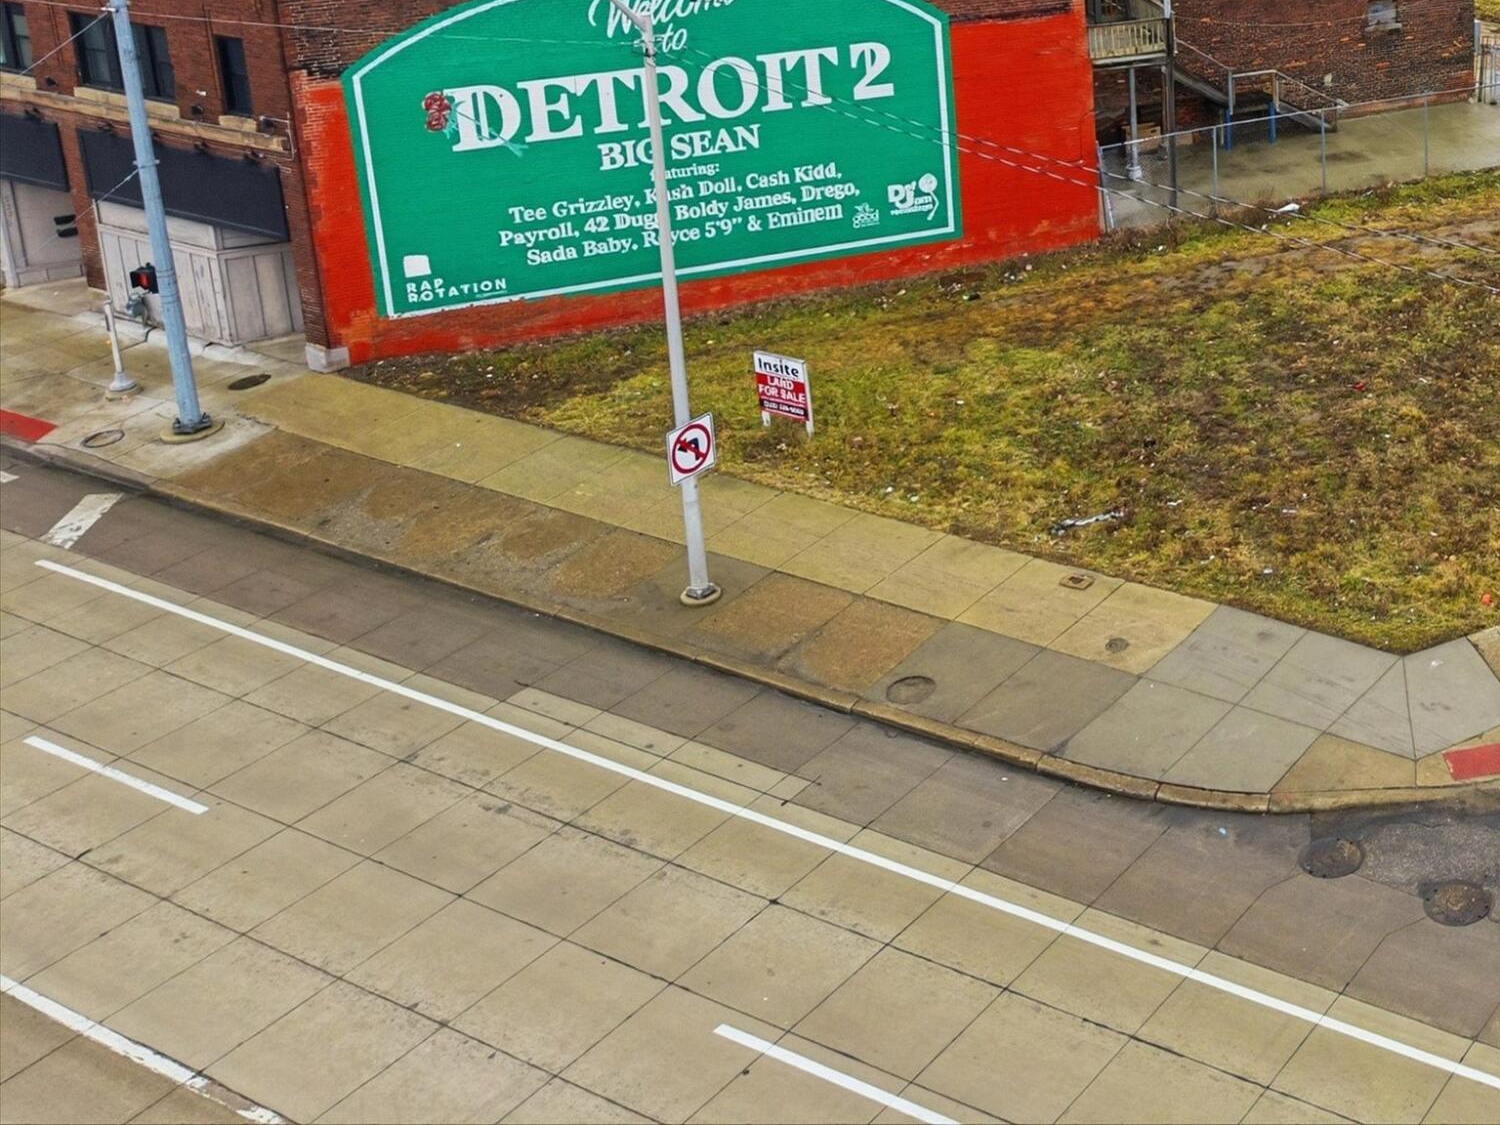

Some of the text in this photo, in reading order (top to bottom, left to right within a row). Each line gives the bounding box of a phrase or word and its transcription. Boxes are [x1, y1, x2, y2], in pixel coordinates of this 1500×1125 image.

[661, 23, 688, 53] to
[443, 41, 895, 152] DETROIT 2
[597, 124, 761, 171] BIG SEAN
[508, 206, 547, 224] Tee
[746, 171, 790, 189] Cash
[793, 162, 842, 184] Kidd,
[499, 182, 861, 247] Payroll, 42 Dug Boldy James, Drego,
[526, 245, 578, 266] Sada
[641, 228, 701, 248] Ryce
[747, 215, 763, 232] &
[766, 204, 844, 229] Eminem
[406, 278, 444, 293] RAP
[408, 278, 507, 303] ROTATION
[758, 357, 799, 378] Insite
[758, 384, 806, 404] FOR SALE
